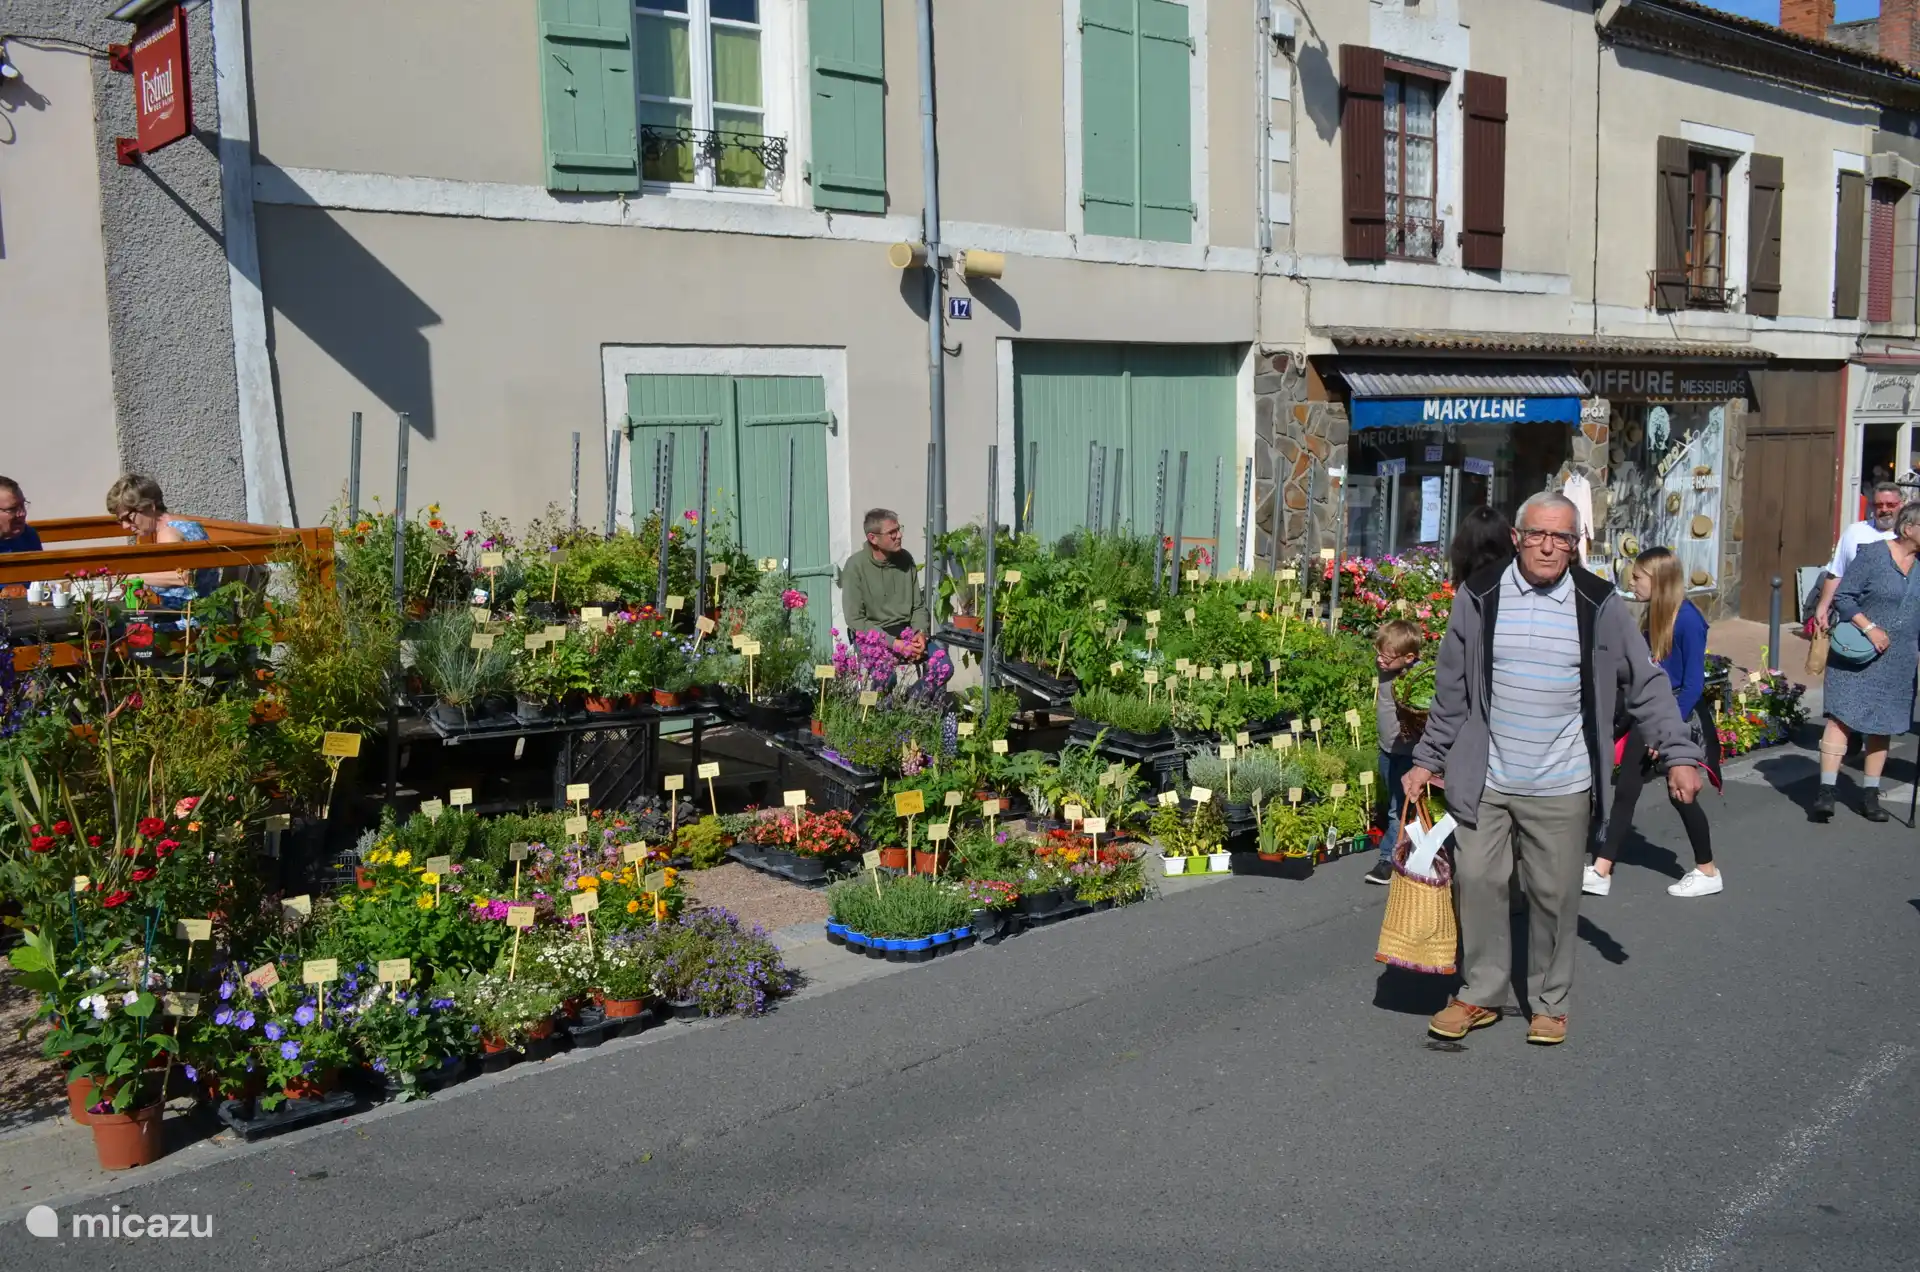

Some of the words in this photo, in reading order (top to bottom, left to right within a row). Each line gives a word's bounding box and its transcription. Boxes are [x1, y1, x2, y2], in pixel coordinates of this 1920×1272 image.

[141, 58, 173, 115] Festival
[953, 300, 968, 316] 17
[1576, 368, 1673, 394] OIFFURE
[1681, 379, 1745, 395] MESSIEURS
[1423, 397, 1527, 421] MARYLENE
[1358, 426, 1426, 447] MERCERIE
